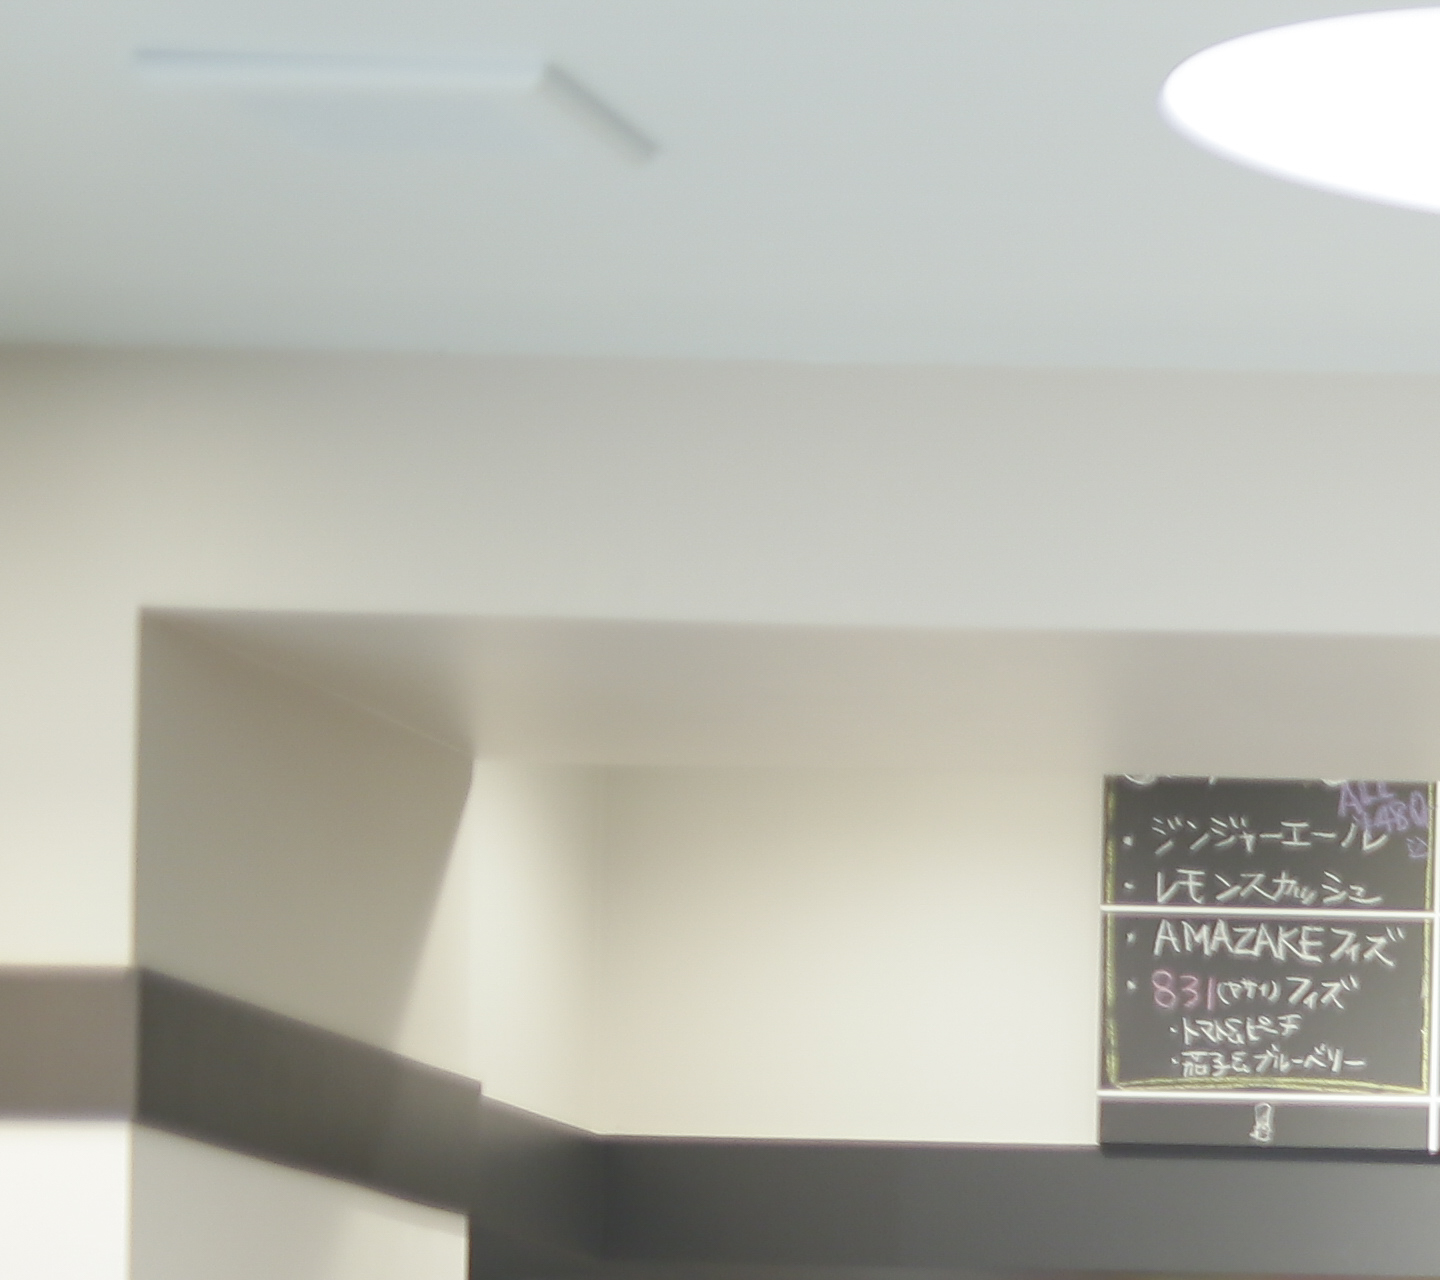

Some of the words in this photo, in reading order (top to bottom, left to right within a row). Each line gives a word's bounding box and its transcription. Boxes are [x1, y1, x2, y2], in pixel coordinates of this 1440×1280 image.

[1151, 815, 1389, 855] ジンジャーエール
[1156, 868, 1384, 905] レモンスカッシュ
